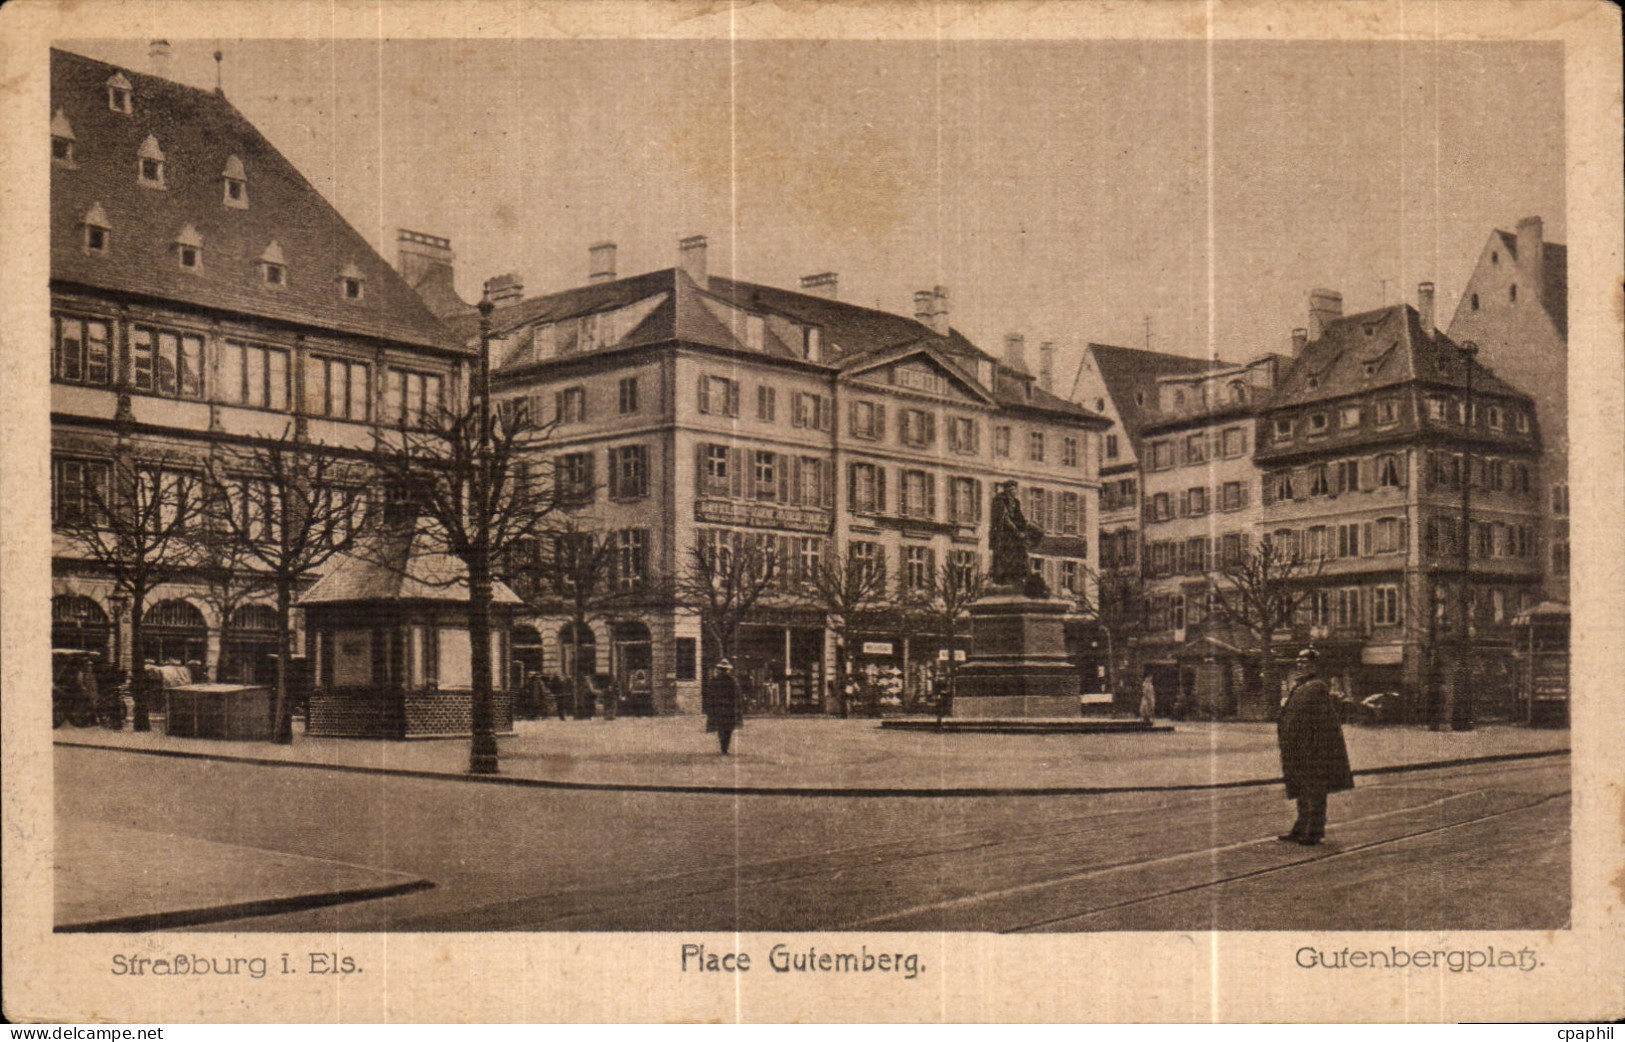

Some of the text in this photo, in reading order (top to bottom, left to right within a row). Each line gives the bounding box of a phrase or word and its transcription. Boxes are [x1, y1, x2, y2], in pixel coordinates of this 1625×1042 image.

[111, 953, 363, 978] Straßburg i. Els.
[681, 944, 925, 979] Place Gutemberg.
